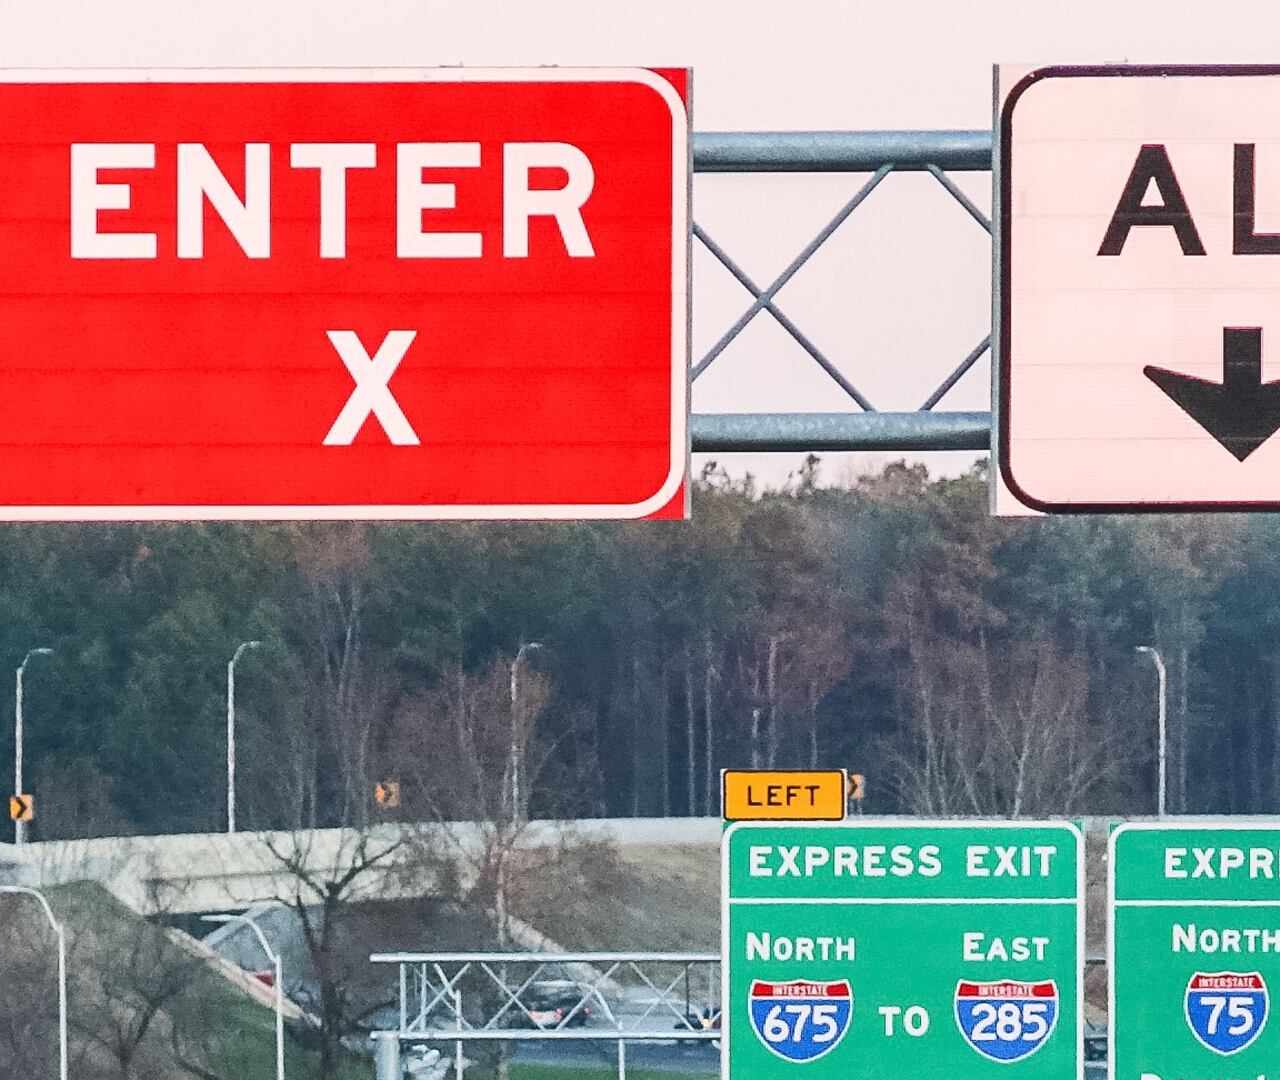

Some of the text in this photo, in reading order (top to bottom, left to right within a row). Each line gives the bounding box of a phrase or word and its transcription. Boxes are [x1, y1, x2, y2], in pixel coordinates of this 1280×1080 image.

[70, 142, 596, 261] ENTER
[747, 785, 820, 807] LEFT
[749, 845, 1057, 877] EXPRESS EXIT
[745, 932, 855, 961] NORTH
[963, 932, 1050, 962] EAST
[1198, 977, 1255, 989] INTERSTATE
[763, 1004, 838, 1043] 675
[878, 1005, 930, 1037] TO
[970, 1003, 1048, 1042] 285
[1200, 996, 1254, 1035] 75
